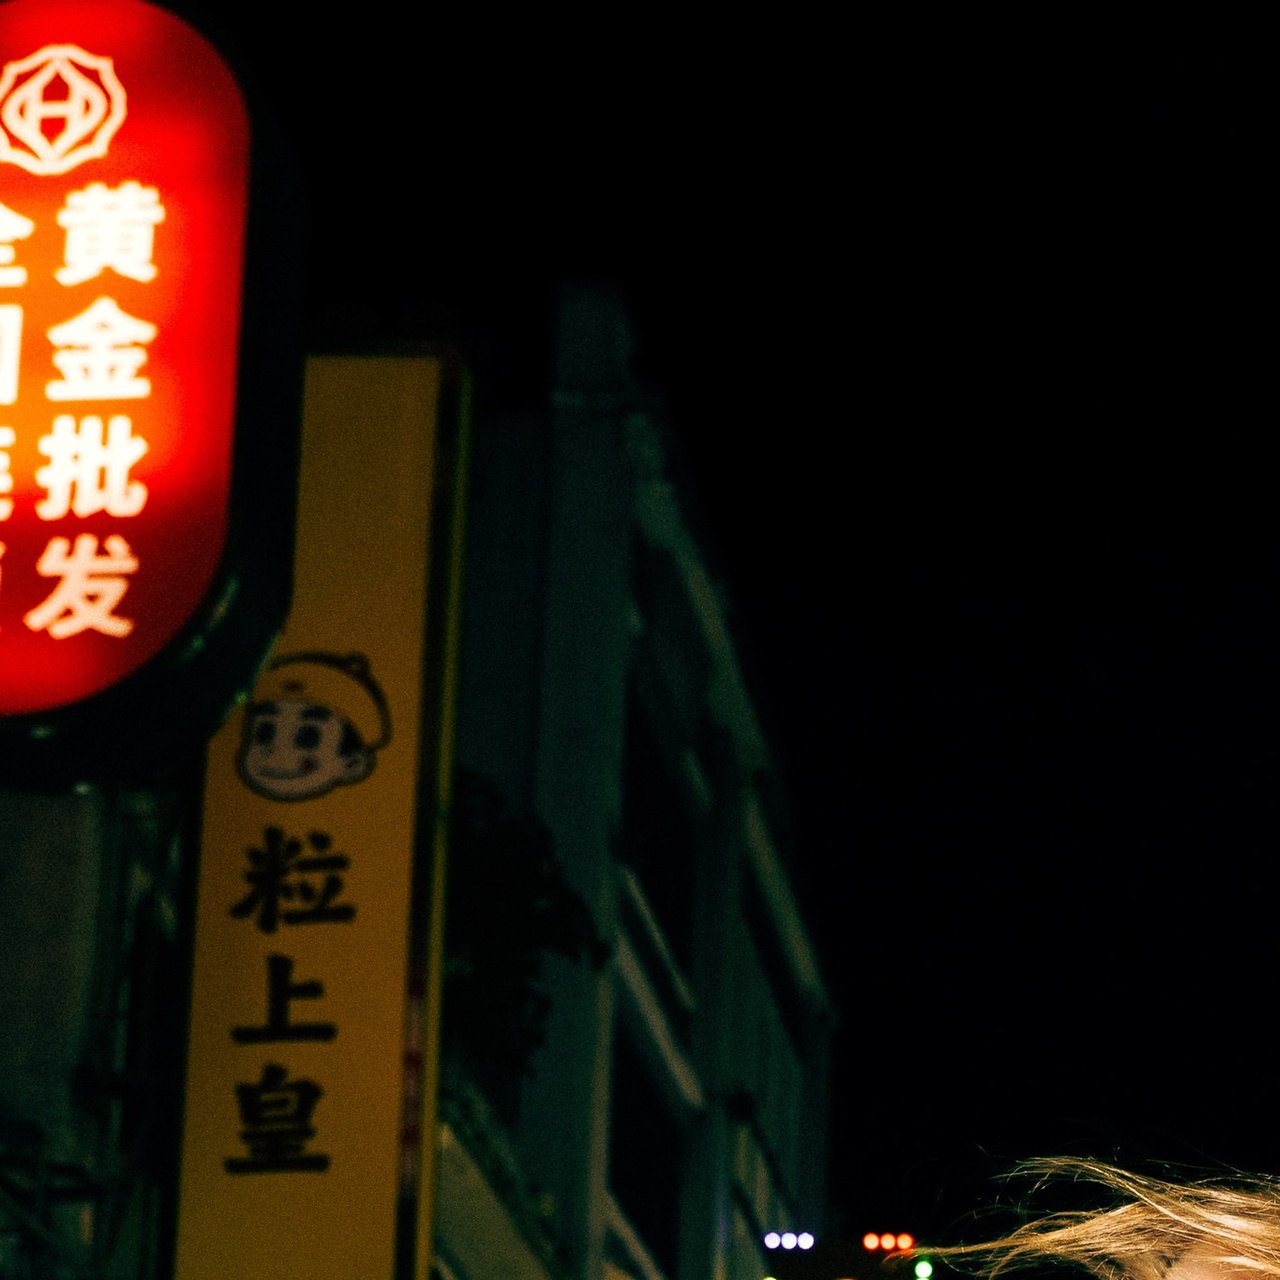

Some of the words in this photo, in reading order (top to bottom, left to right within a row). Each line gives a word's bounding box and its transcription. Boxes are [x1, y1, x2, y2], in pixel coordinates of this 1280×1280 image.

[23, 182, 165, 639] 黄金批发
[224, 826, 357, 1176] 粒上皇
